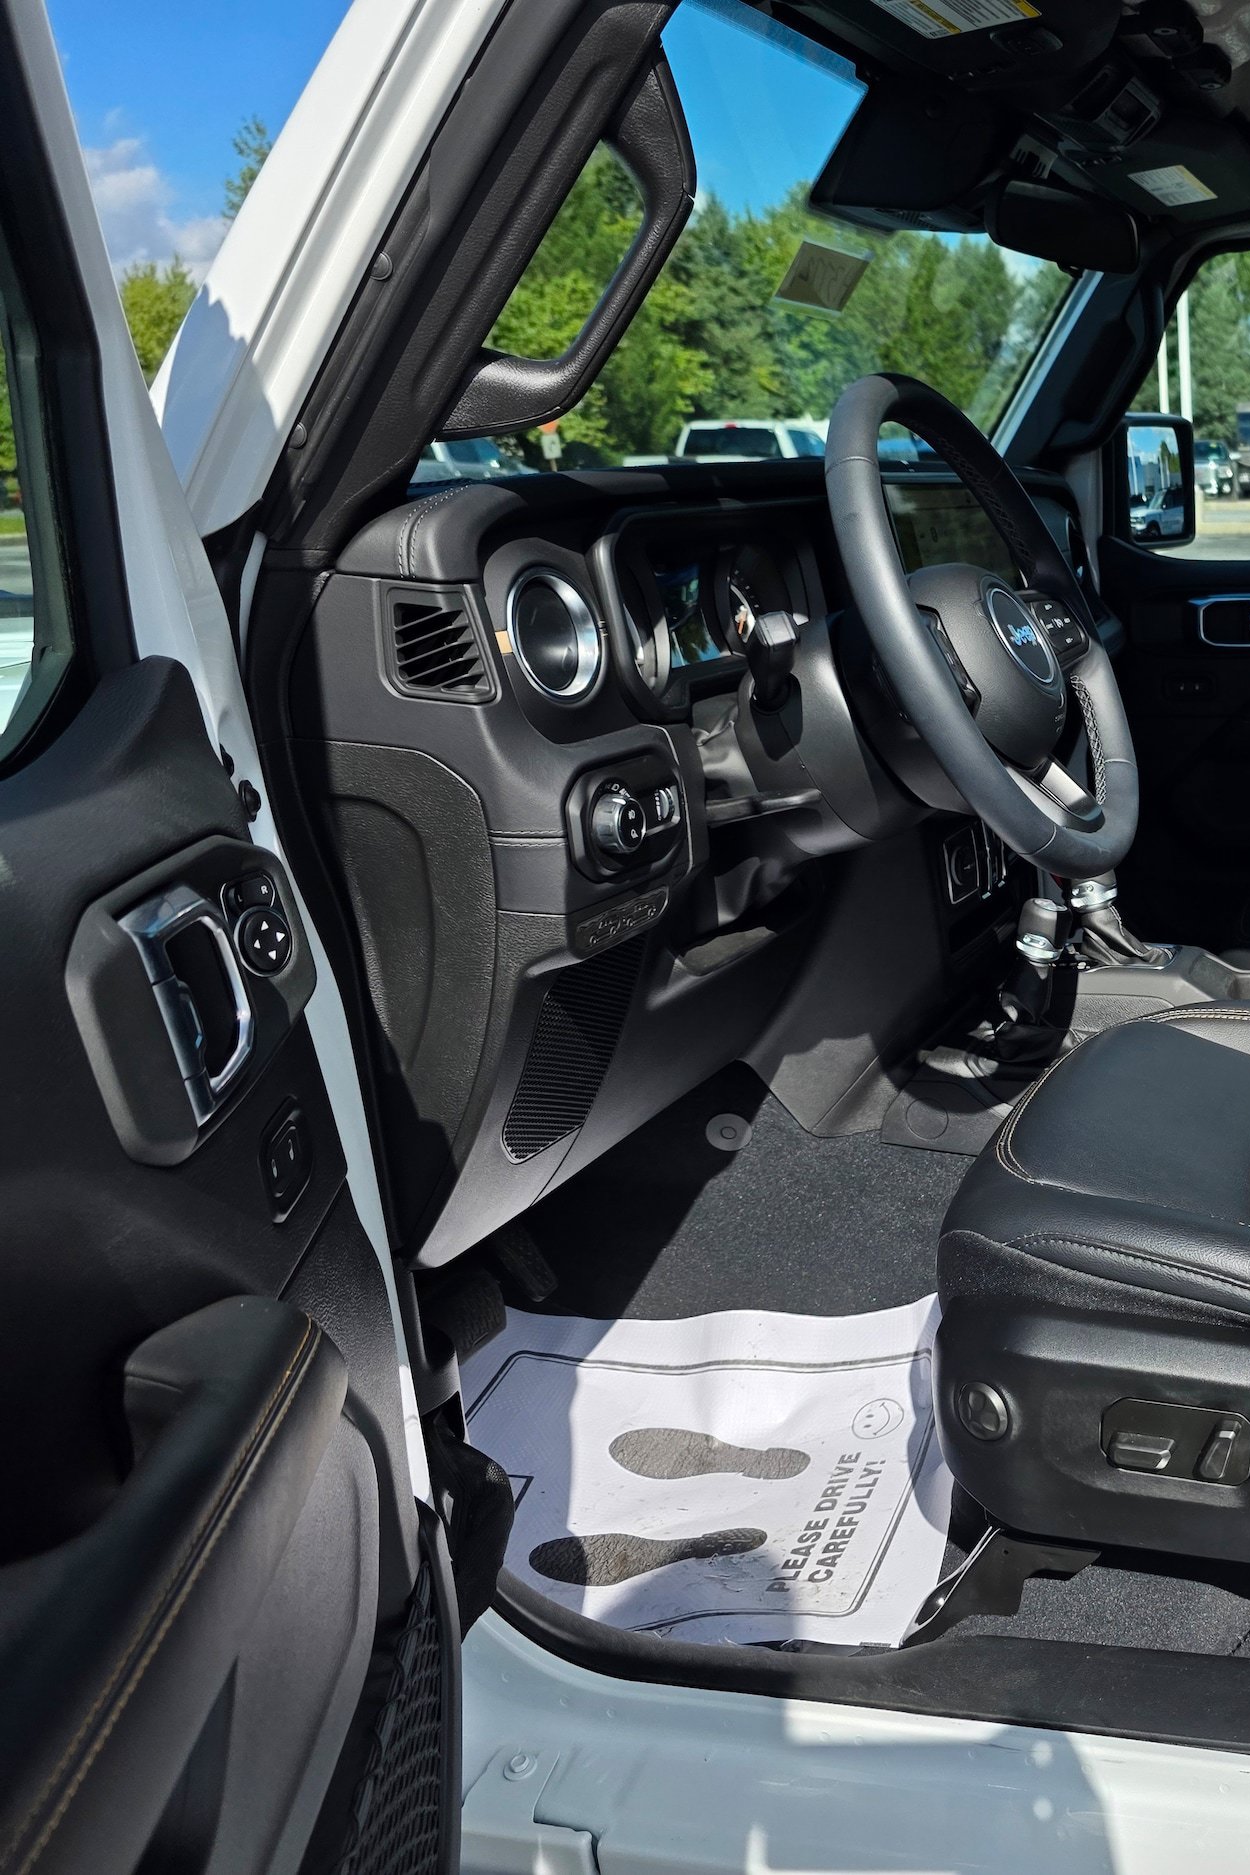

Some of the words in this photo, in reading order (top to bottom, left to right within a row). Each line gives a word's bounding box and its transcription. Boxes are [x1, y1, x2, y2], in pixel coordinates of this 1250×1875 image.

[260, 885, 269, 894] R
[766, 1517, 829, 1592] PLEASE
[815, 1452, 861, 1512] DRIVE
[809, 1460, 886, 1582] CAREFULLY!
